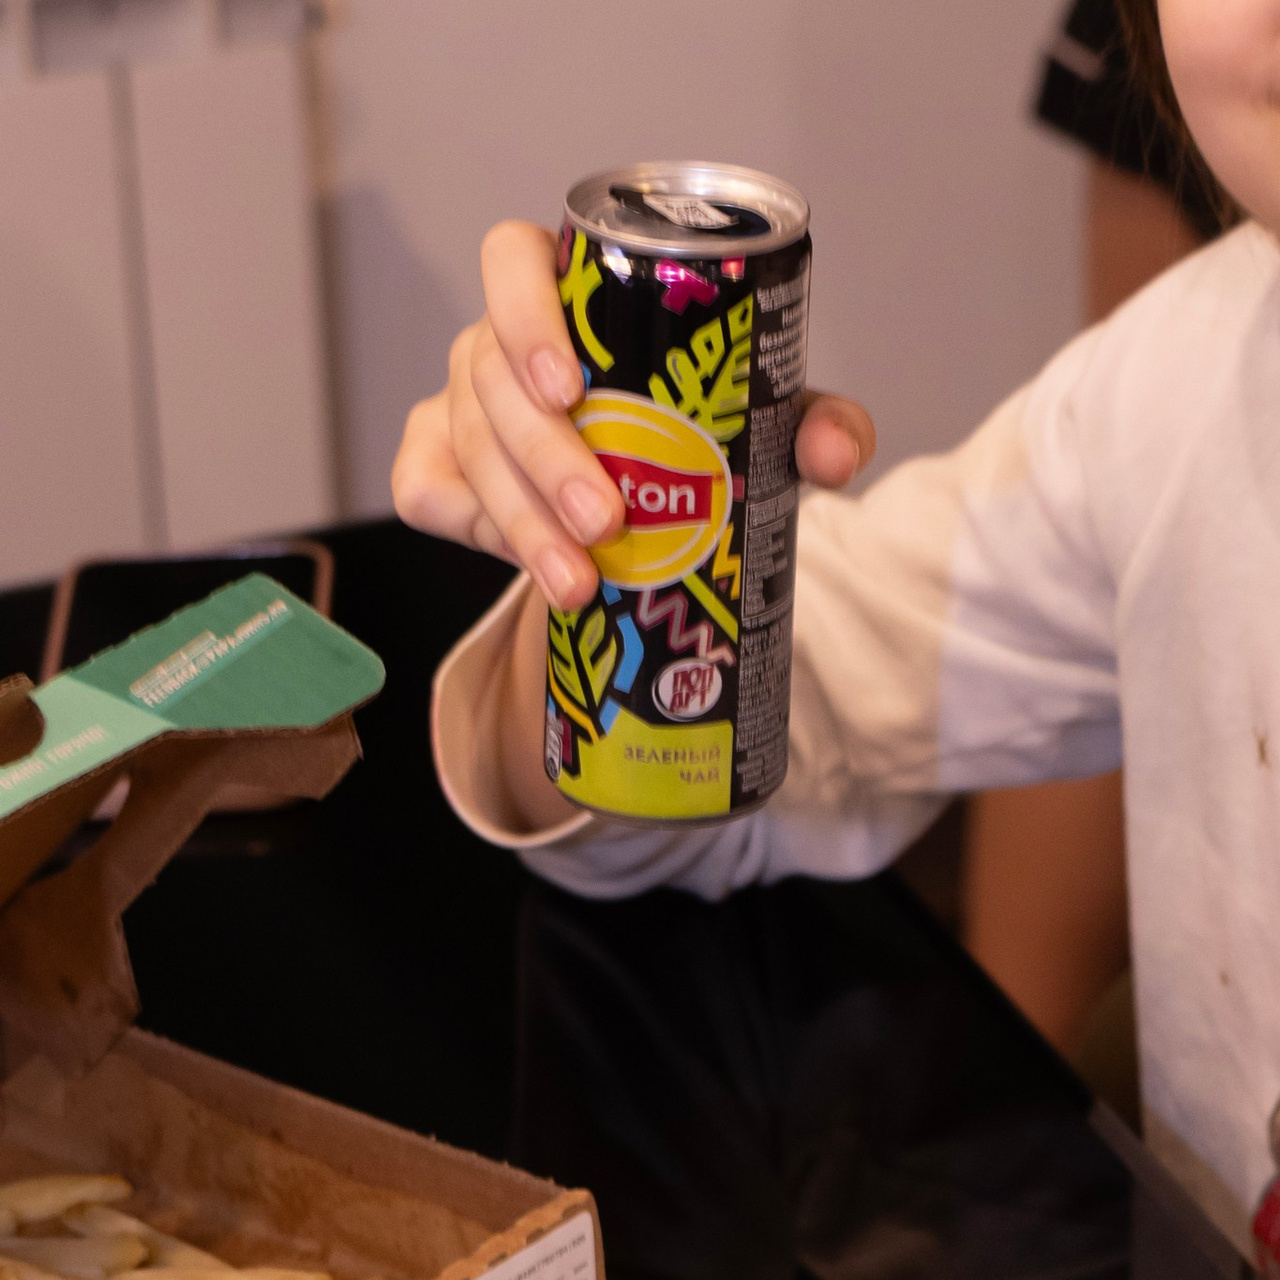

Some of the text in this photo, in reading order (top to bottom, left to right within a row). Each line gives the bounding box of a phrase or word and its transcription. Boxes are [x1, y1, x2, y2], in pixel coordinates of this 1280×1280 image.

[619, 473, 696, 515] ton
[624, 744, 721, 765] ЗЕЛЕНЫЙ
[679, 768, 721, 785] ЧАЙ
